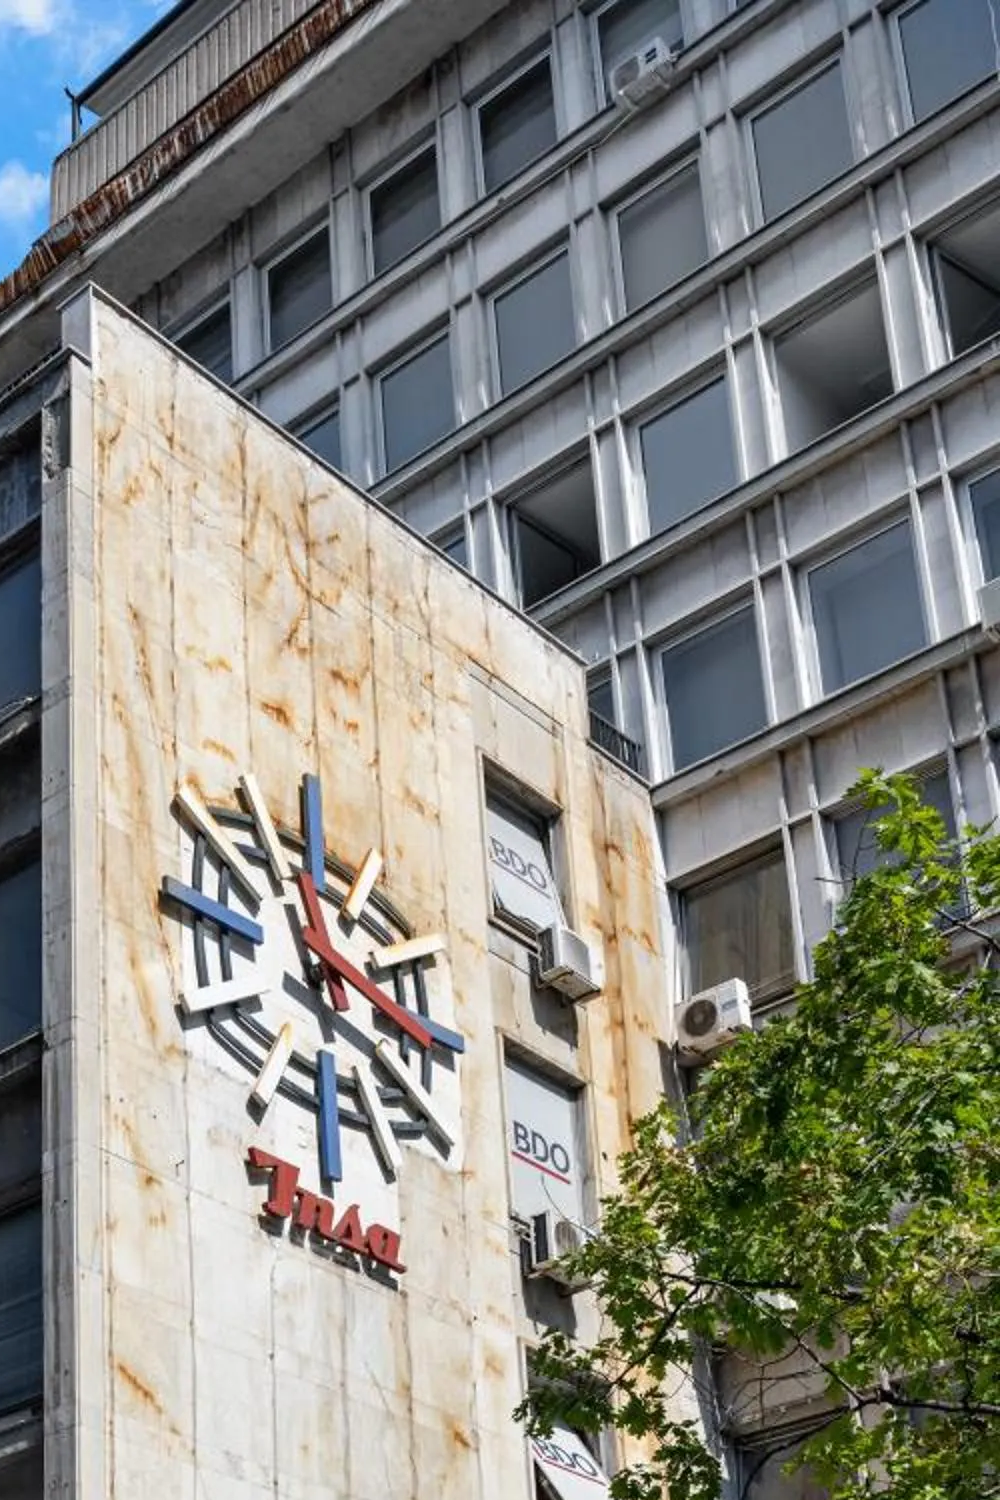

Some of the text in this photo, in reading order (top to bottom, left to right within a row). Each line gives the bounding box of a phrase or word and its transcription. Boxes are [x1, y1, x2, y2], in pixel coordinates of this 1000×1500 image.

[491, 836, 547, 888] BDO
[513, 1120, 570, 1174] BDO
[533, 1437, 598, 1477] BDO
